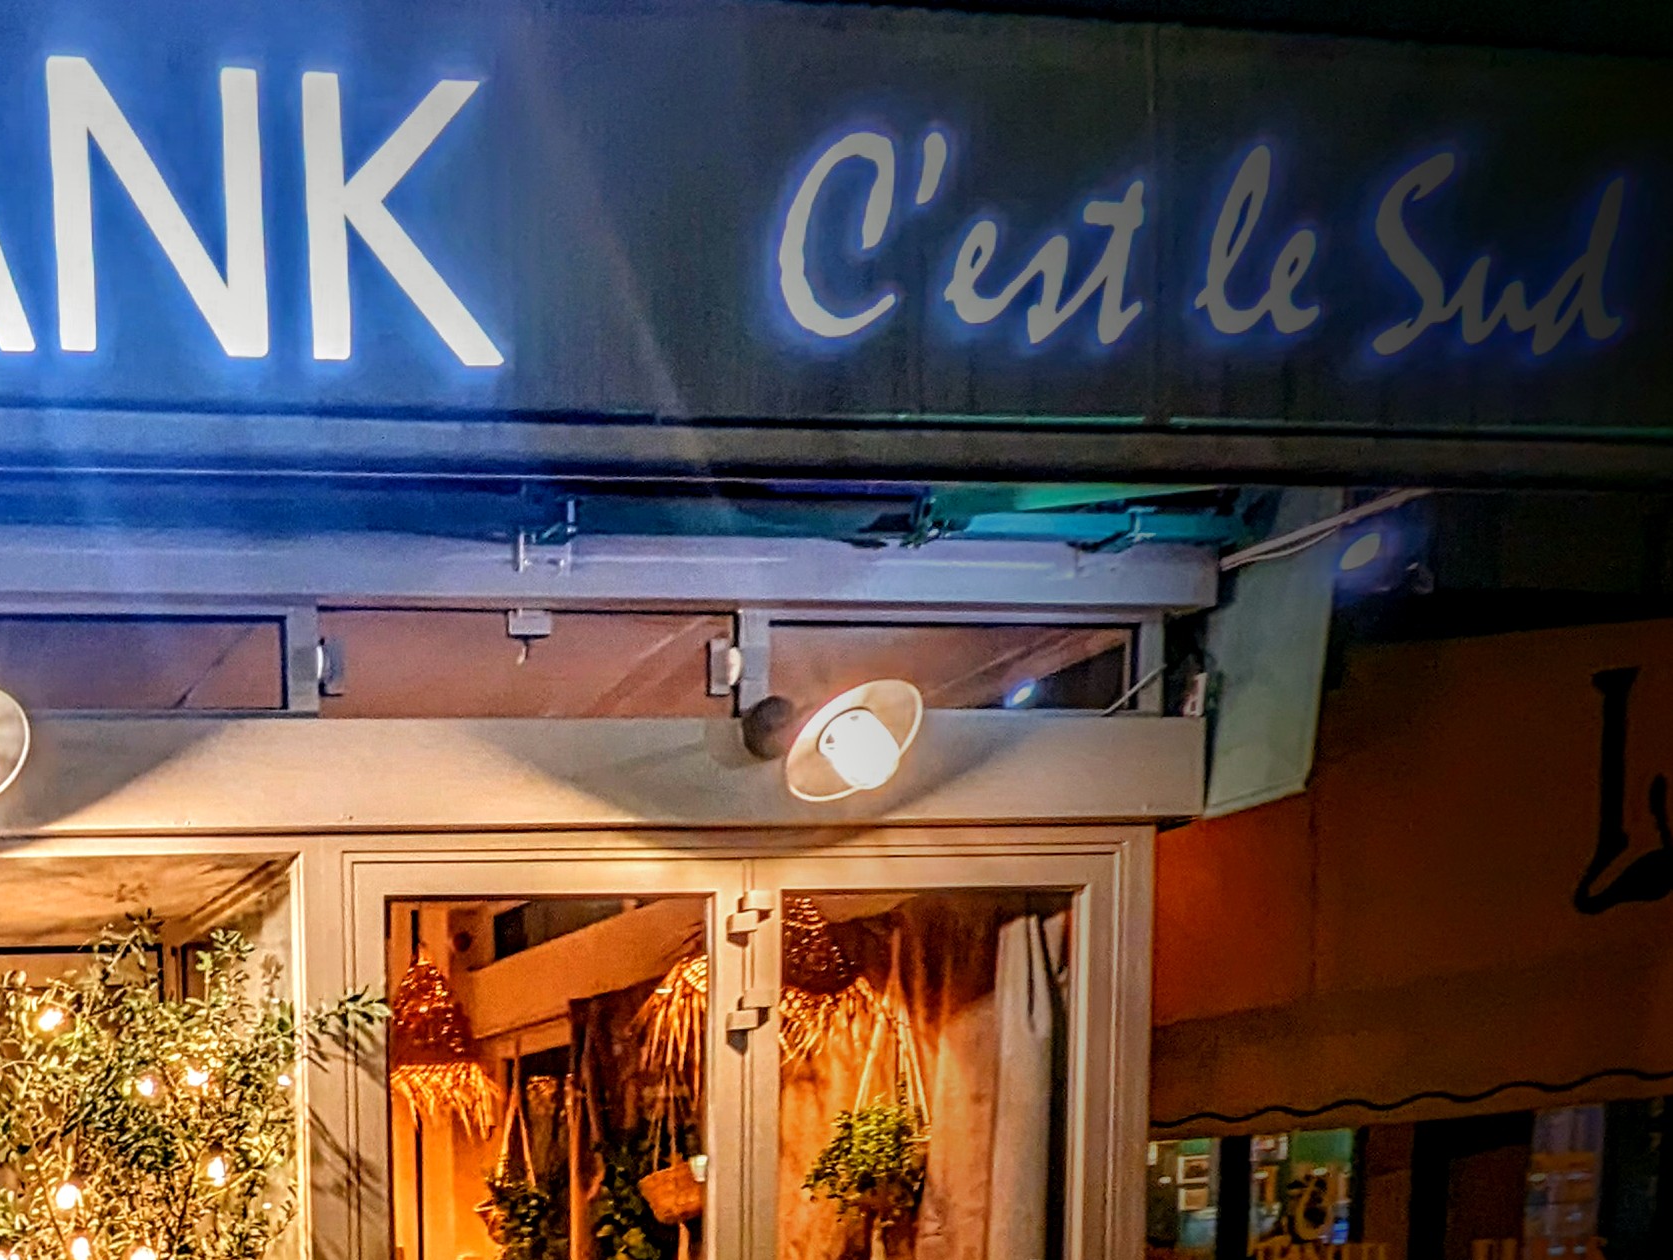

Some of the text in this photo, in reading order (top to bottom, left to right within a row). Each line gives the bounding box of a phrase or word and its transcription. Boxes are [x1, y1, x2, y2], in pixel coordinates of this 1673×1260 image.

[779, 130, 1624, 356] C'est le Sud
